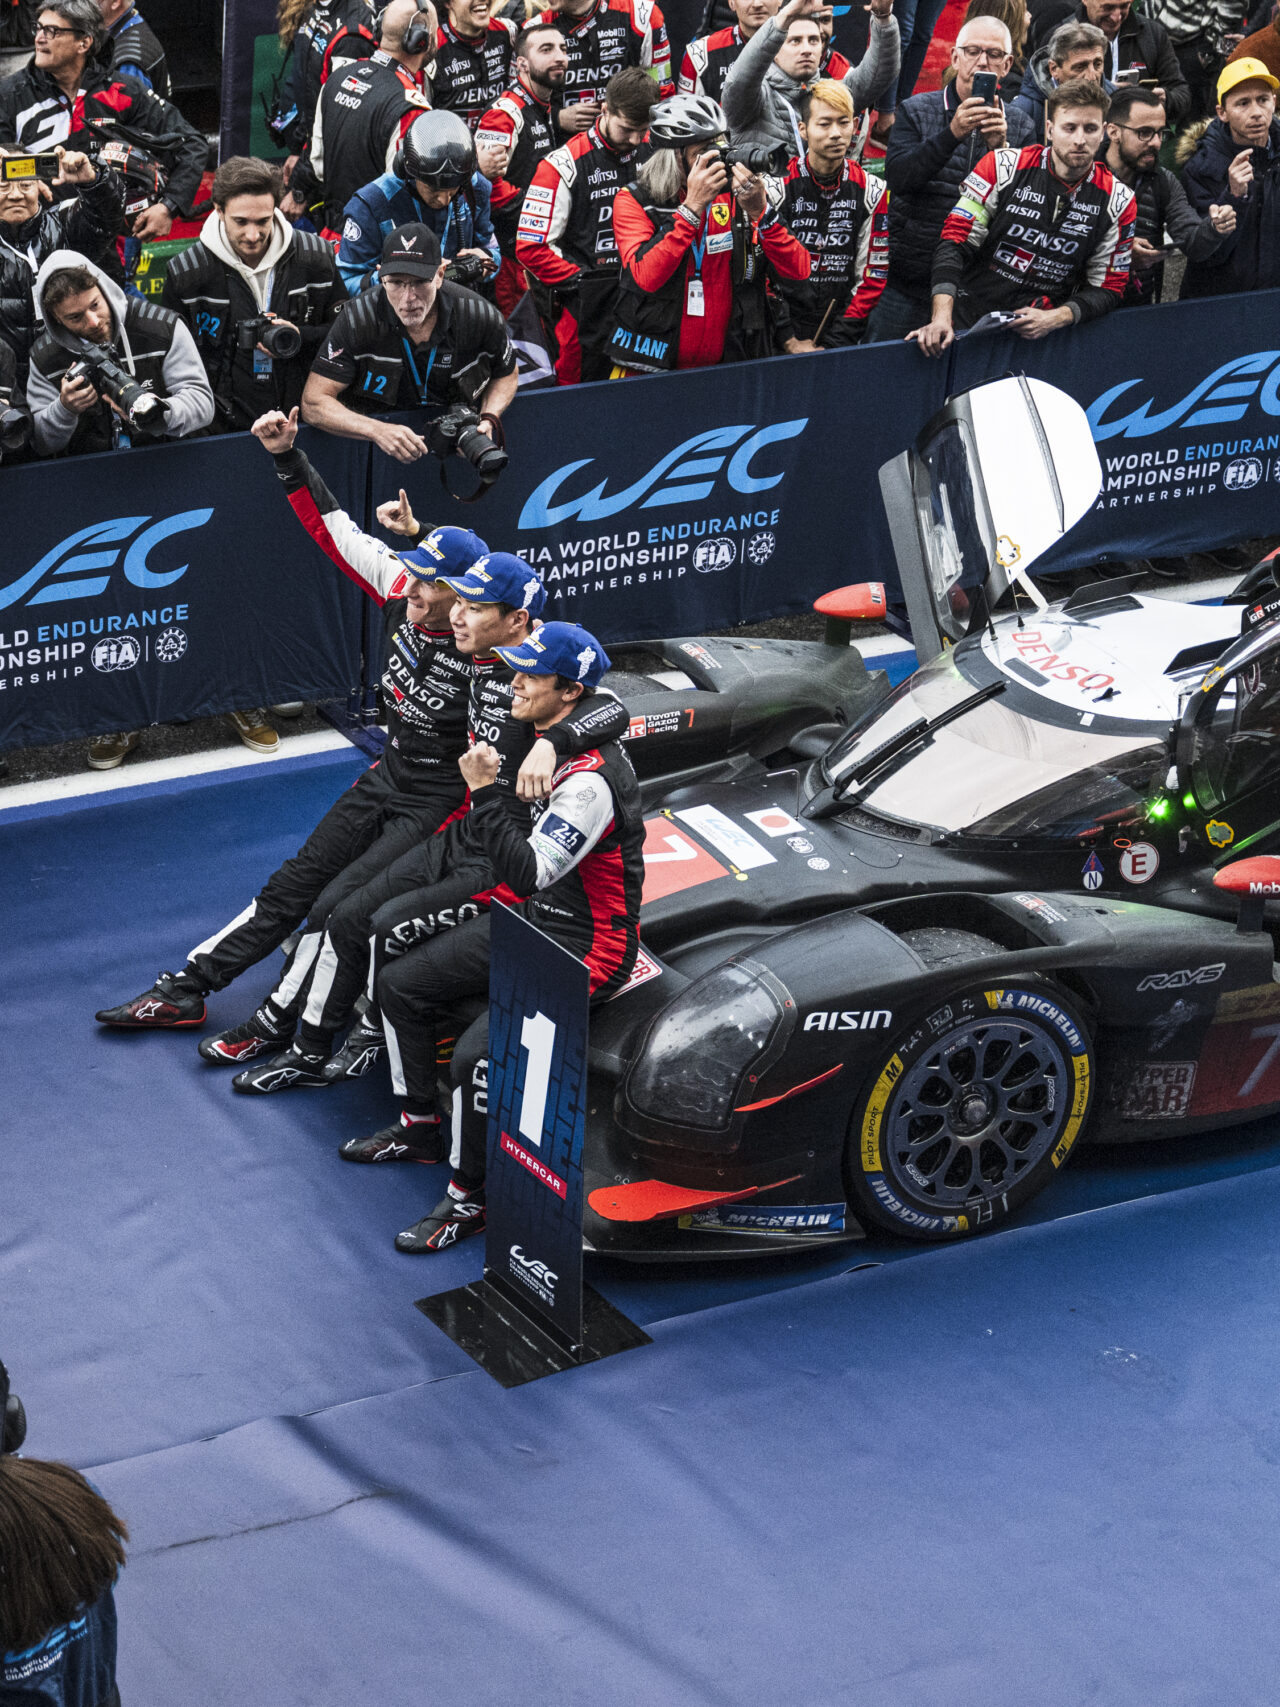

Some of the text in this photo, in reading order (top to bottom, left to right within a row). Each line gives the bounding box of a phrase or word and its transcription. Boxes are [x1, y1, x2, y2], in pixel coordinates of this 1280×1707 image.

[599, 38, 619, 48] ZENT
[445, 58, 471, 77] FUJITSU
[487, 57, 501, 67] ZENT
[452, 73, 476, 87] AISIN
[565, 64, 622, 85] DENSO
[334, 92, 362, 110] DENSO
[455, 81, 504, 105] DENSO
[588, 168, 618, 186] FUJITSU
[590, 187, 620, 200] AISIN
[1013, 185, 1046, 205] FUJITSU
[829, 211, 851, 219] ZENT
[1005, 204, 1041, 220] AISIN
[1067, 210, 1090, 223] ZENT
[1006, 223, 1079, 255] DENSO
[994, 249, 1032, 273] GR
[612, 327, 633, 348] PIT
[363, 370, 388, 395] 12
[1106, 434, 1280, 474] WORLD ENDURAN
[517, 417, 809, 530] WEC
[1101, 462, 1221, 492] MPIONSHIP
[1096, 483, 1217, 510] ARTNERSHIP
[517, 508, 780, 565] FIA WORLD ENDURANCE
[536, 543, 689, 584] HAMPIONSHIP
[1249, 600, 1280, 622] GR TOY
[37, 603, 189, 643] ENDURANCE
[400, 623, 421, 658] AISIN
[434, 651, 461, 672] Mobil
[1012, 631, 1114, 690] DENSO
[388, 653, 445, 711] DENSO
[430, 664, 454, 679] ZENT
[480, 692, 499, 704] ZENT
[485, 680, 507, 696] Mobil
[583, 704, 623, 730] KINSHUKAI
[647, 710, 681, 722] TOYOTA
[647, 717, 679, 728] GAZOO
[685, 708, 695, 728] 7
[647, 724, 679, 735] Racing
[552, 821, 581, 847] 24h
[1131, 854, 1147, 876] E
[1088, 872, 1098, 888] N
[1249, 882, 1280, 895] Mob
[384, 902, 478, 957] DENSO
[1137, 962, 1226, 992] RAYS
[803, 1010, 893, 1031] AISIN
[1017, 995, 1082, 1048] MICHELIN
[519, 1010, 557, 1147] 1
[886, 1065, 900, 1083] M
[1077, 1061, 1087, 1118] PILOT SPORT
[867, 1106, 880, 1165] PILOT SPORT
[505, 1140, 561, 1190] HYPERCAR
[871, 1179, 941, 1230] MICHELIN
[726, 1212, 832, 1227] MICHELIN
[509, 1244, 559, 1289] WEC
[20, 1655, 49, 1672] WORLD
